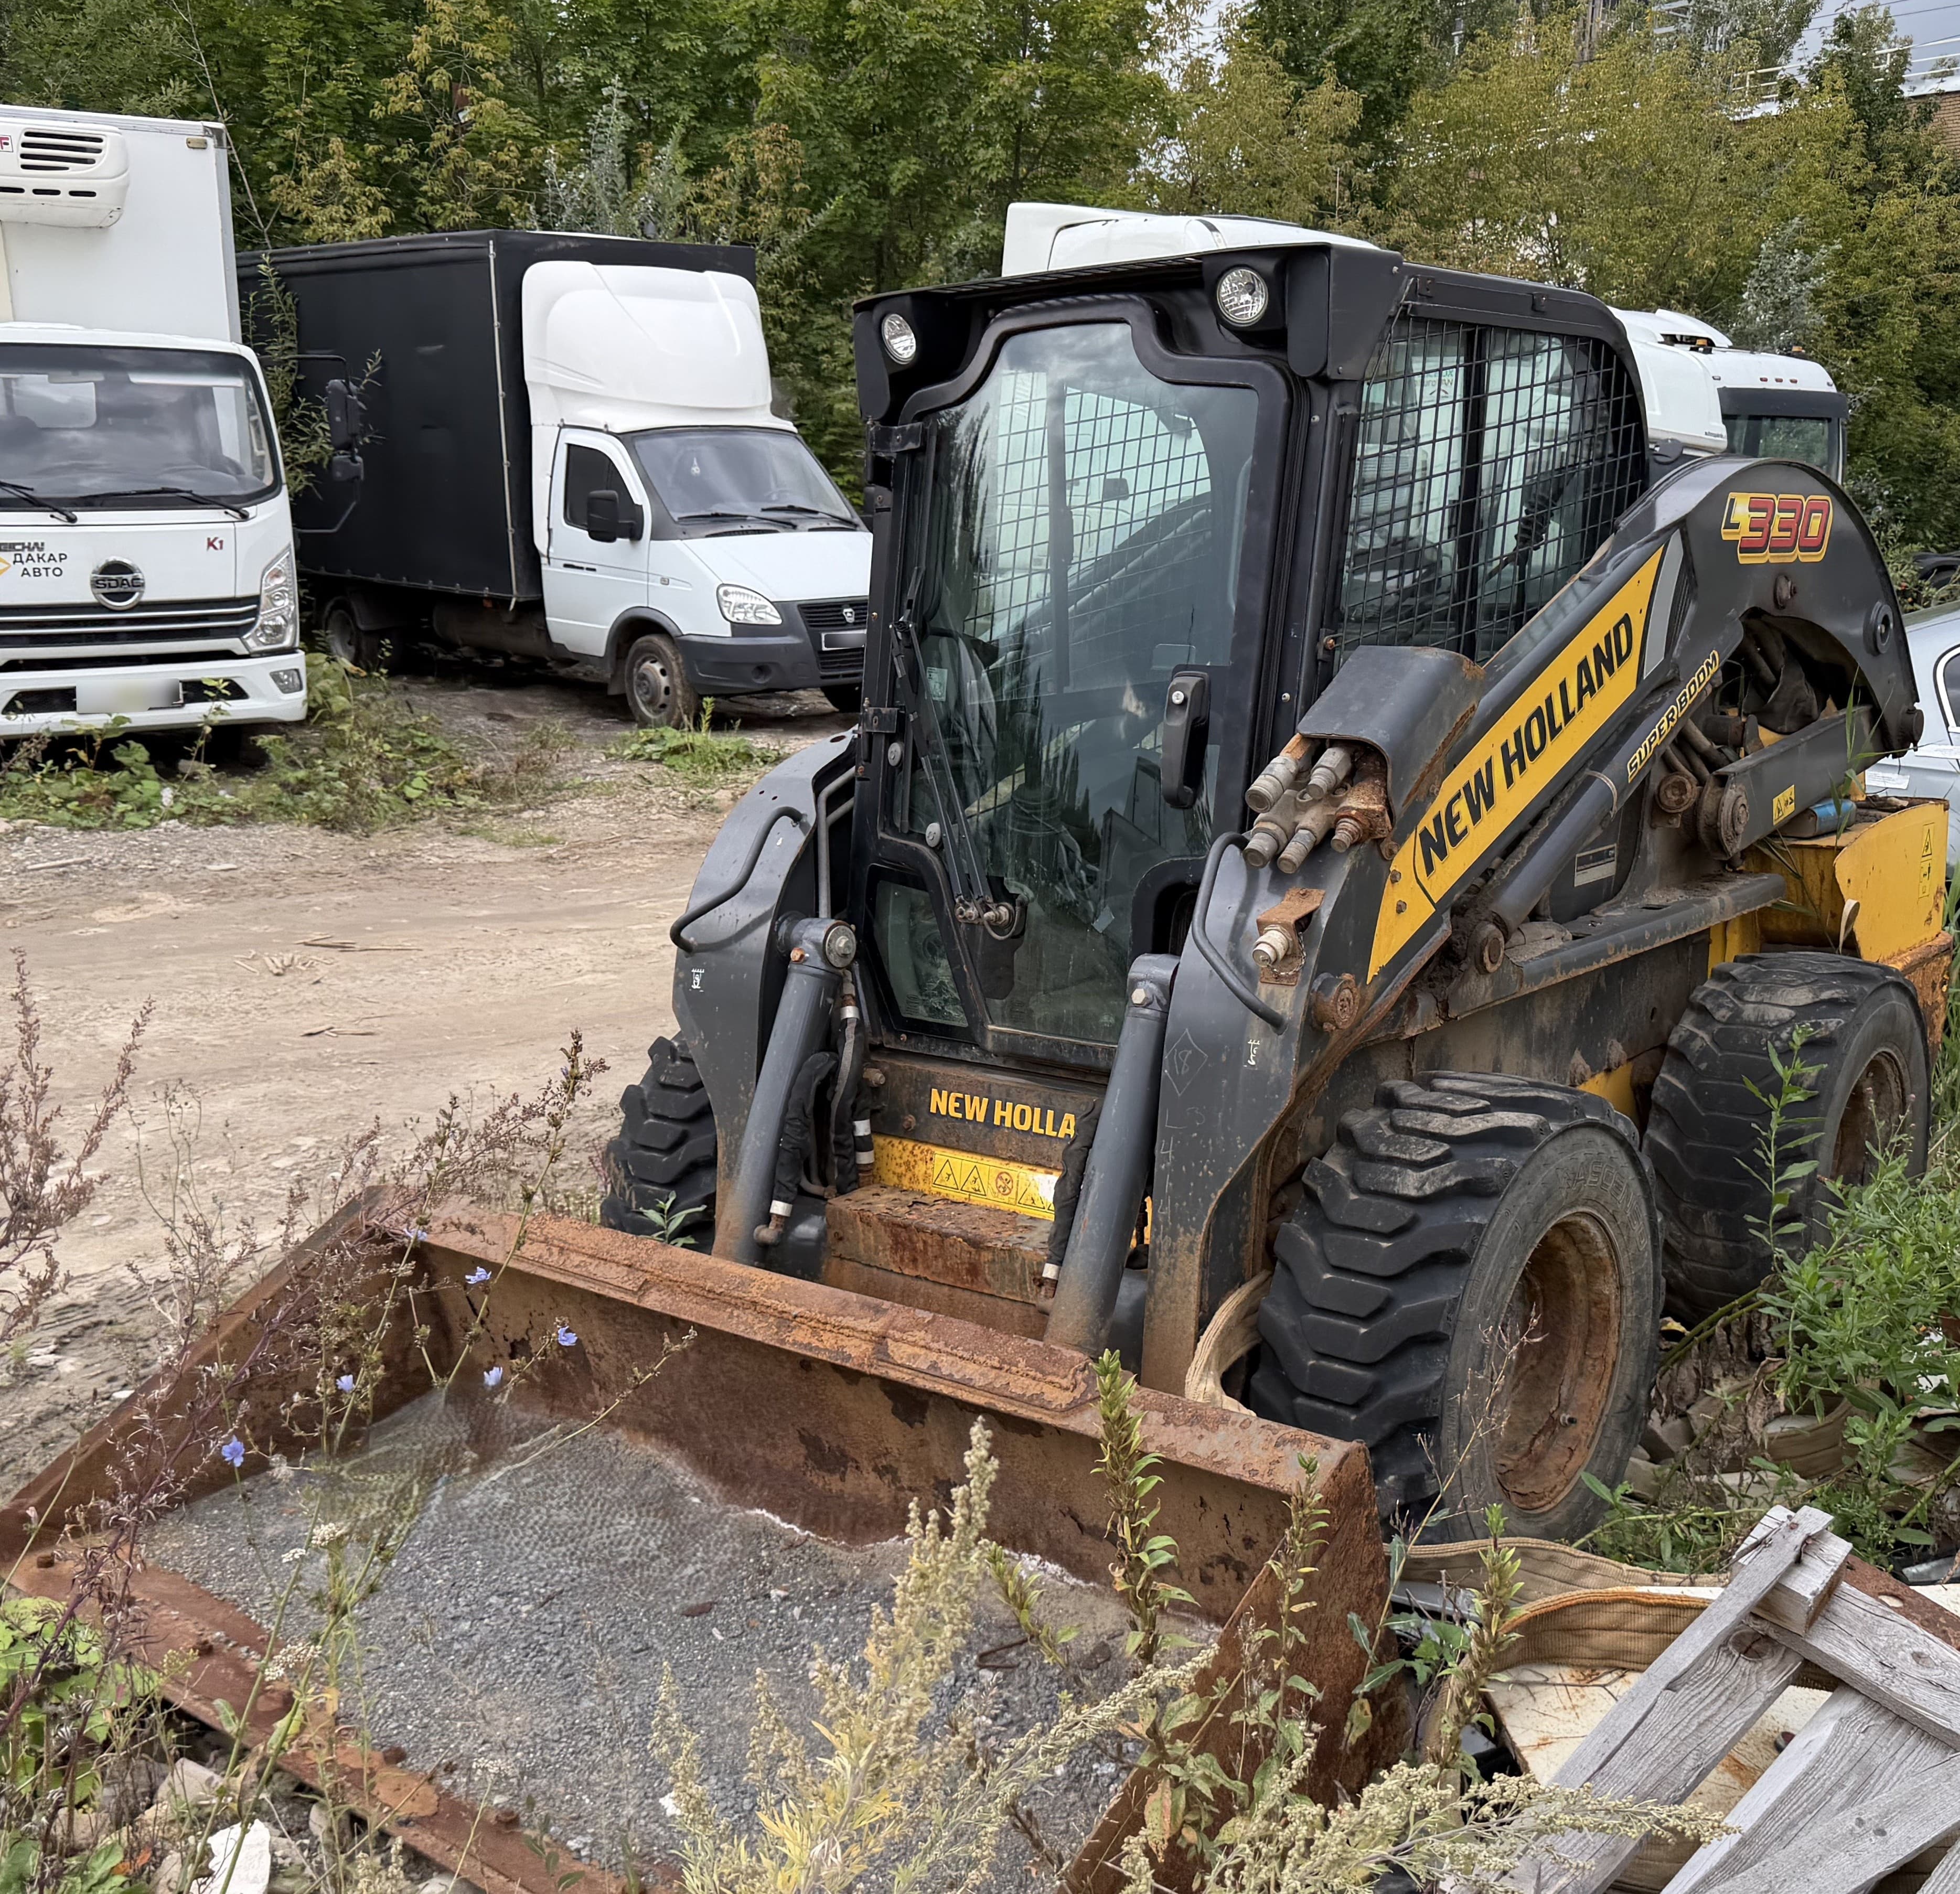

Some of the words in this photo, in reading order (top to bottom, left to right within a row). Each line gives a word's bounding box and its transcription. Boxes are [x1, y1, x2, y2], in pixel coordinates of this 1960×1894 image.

[1721, 492, 1833, 564] L330
[0, 542, 45, 552] EICHAI
[206, 537, 224, 551] K1
[13, 553, 68, 565] ДАКАР
[21, 567, 63, 577] АВТО
[95, 577, 142, 589] SDAC
[1627, 705, 1678, 783] SUPER
[1676, 649, 1720, 718] BOOM
[1418, 755, 1496, 879] NEW
[1500, 612, 1634, 790] HOLLAND
[929, 1088, 989, 1123] NEW
[993, 1099, 1076, 1139] HOLLA
